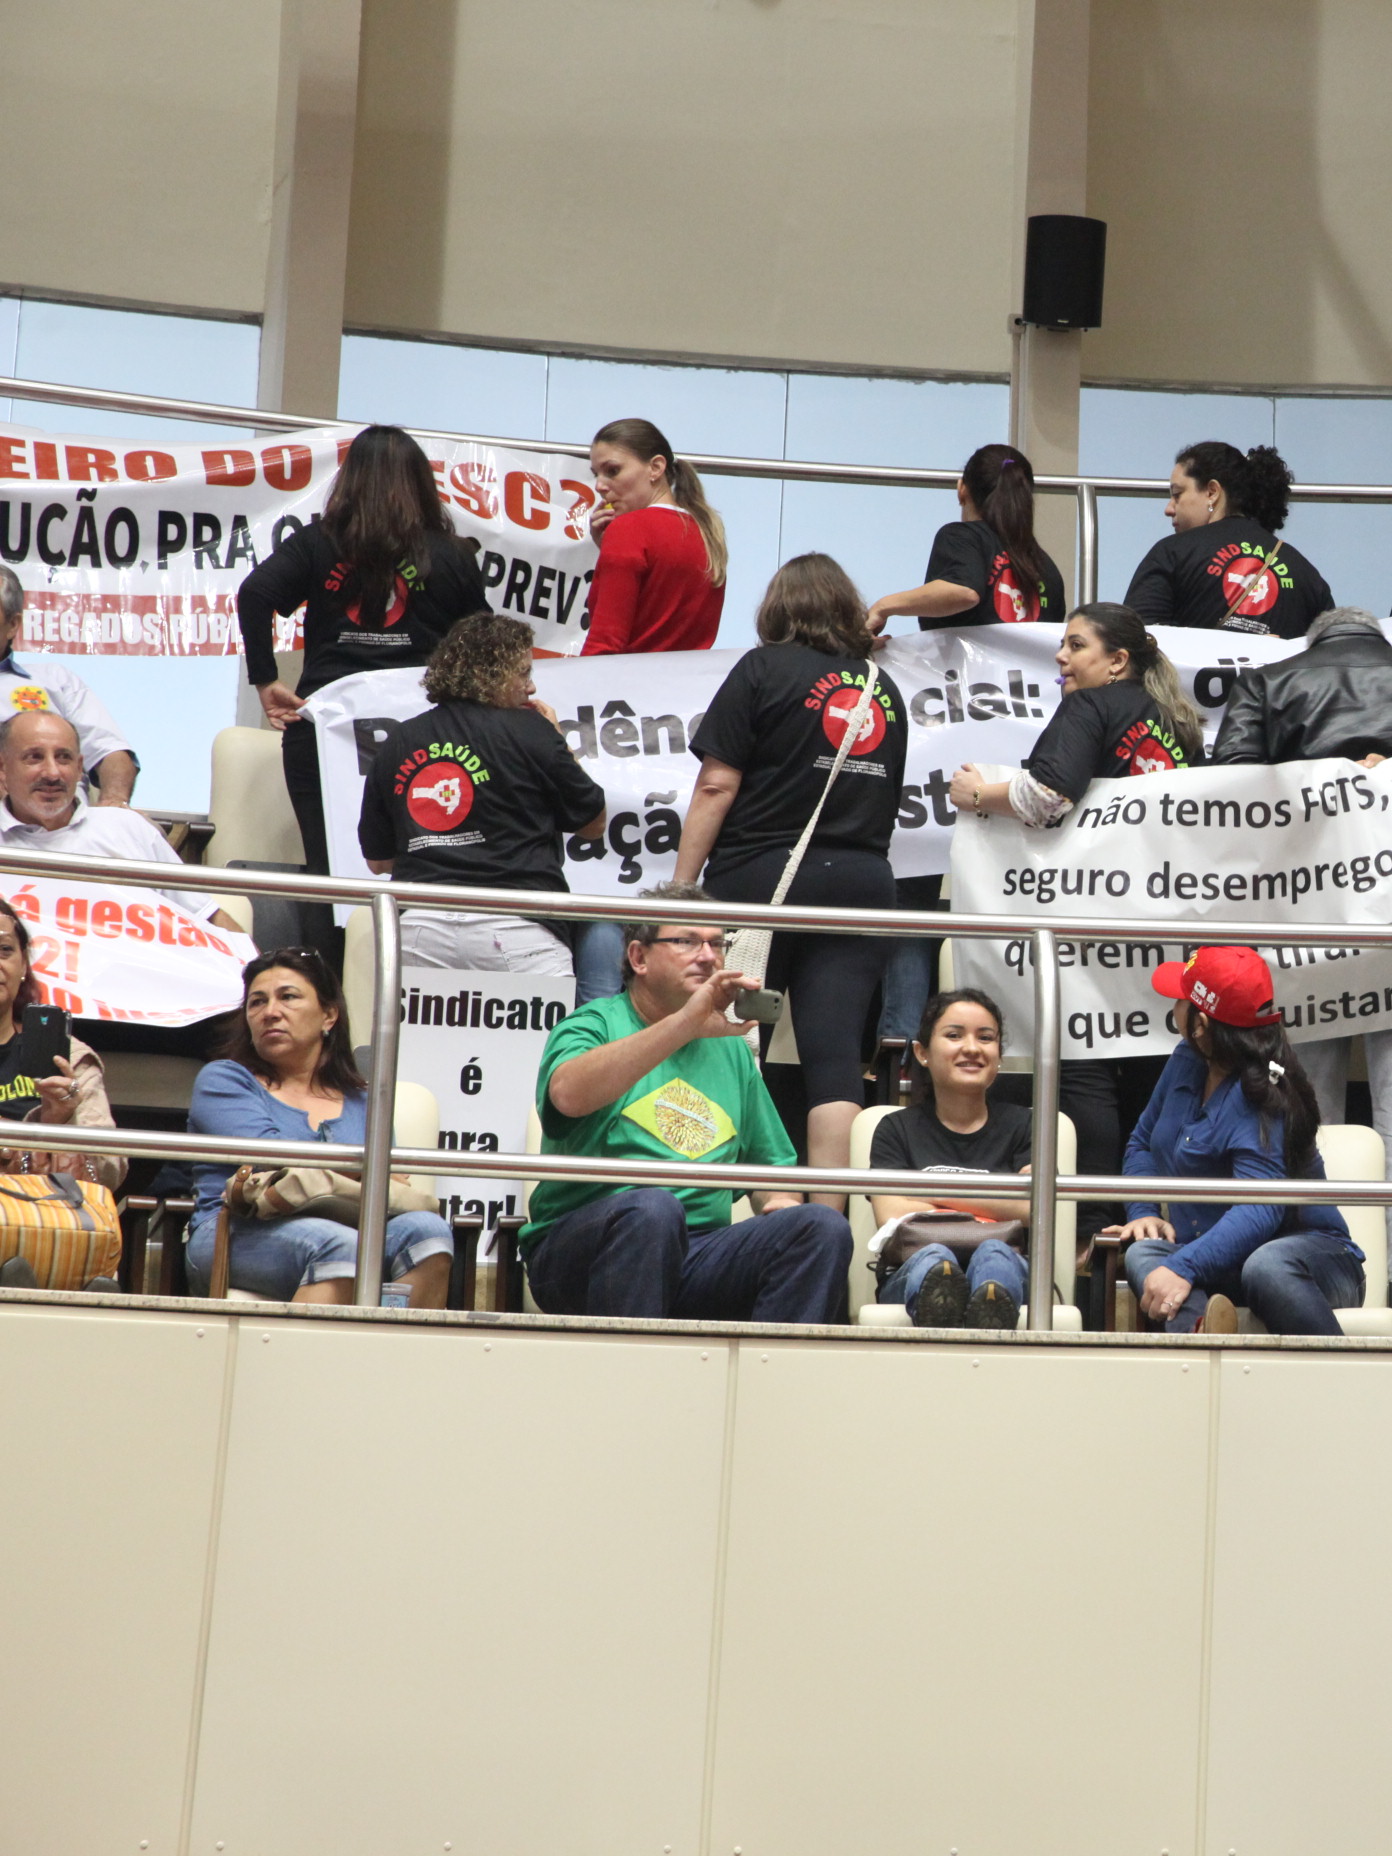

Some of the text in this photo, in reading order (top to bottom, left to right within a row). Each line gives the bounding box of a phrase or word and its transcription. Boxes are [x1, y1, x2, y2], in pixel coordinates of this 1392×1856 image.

[201, 445, 313, 491] DO
[157, 510, 258, 570] PRA
[23, 608, 161, 644] REGADOS
[804, 671, 896, 722] SINDSAÚDE
[393, 742, 490, 795] SINDSAÚDE
[1077, 795, 1147, 829] não
[1159, 793, 1292, 828] temos
[1301, 775, 1389, 822] FGTS,
[1003, 868, 1131, 904] seguro
[1004, 941, 1164, 976] qerem
[1068, 1010, 1149, 1048] que
[460, 1057, 482, 1095] é
